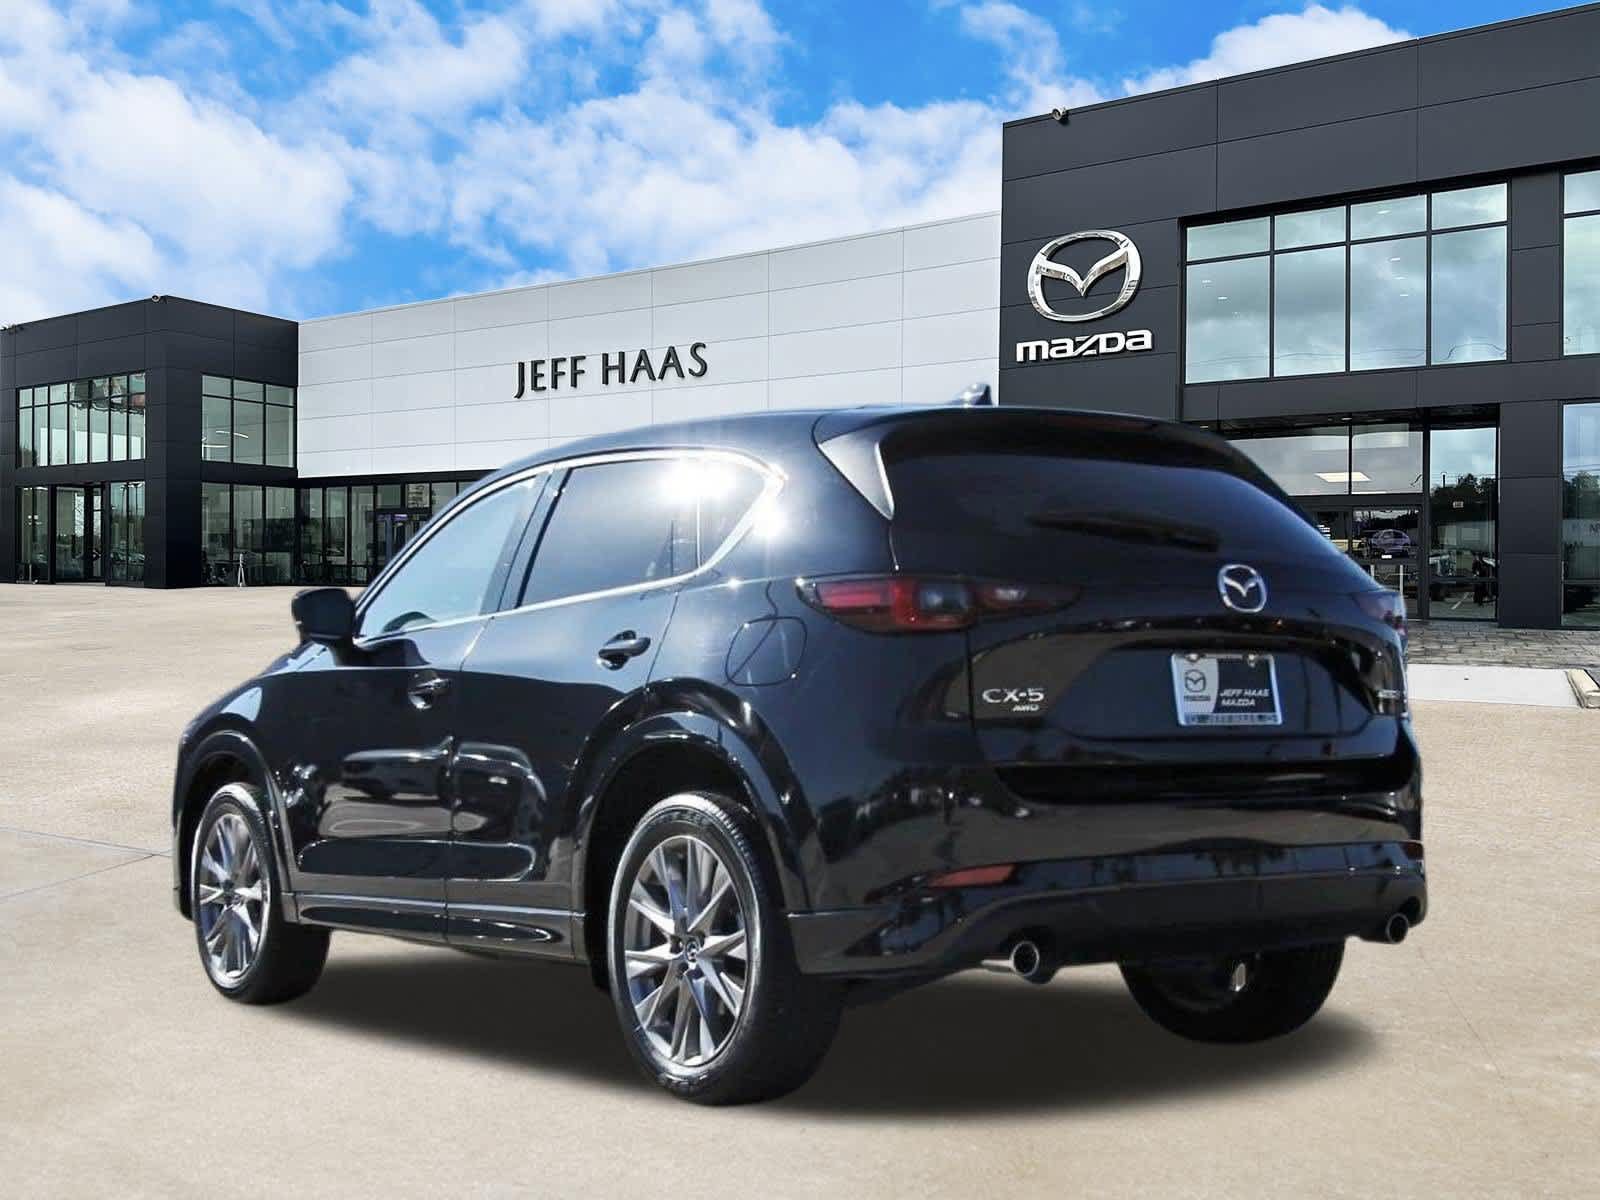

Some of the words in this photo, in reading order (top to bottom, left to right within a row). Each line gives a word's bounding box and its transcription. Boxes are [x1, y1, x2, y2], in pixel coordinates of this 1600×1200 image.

[514, 355, 587, 399] JEFF
[601, 342, 708, 385] HAAS
[982, 687, 1045, 703] CX-5
[1220, 688, 1242, 697] JEFF
[1243, 688, 1270, 697] HAAS
[1221, 698, 1255, 706] MAZDA
[1012, 703, 1039, 712] AWD
